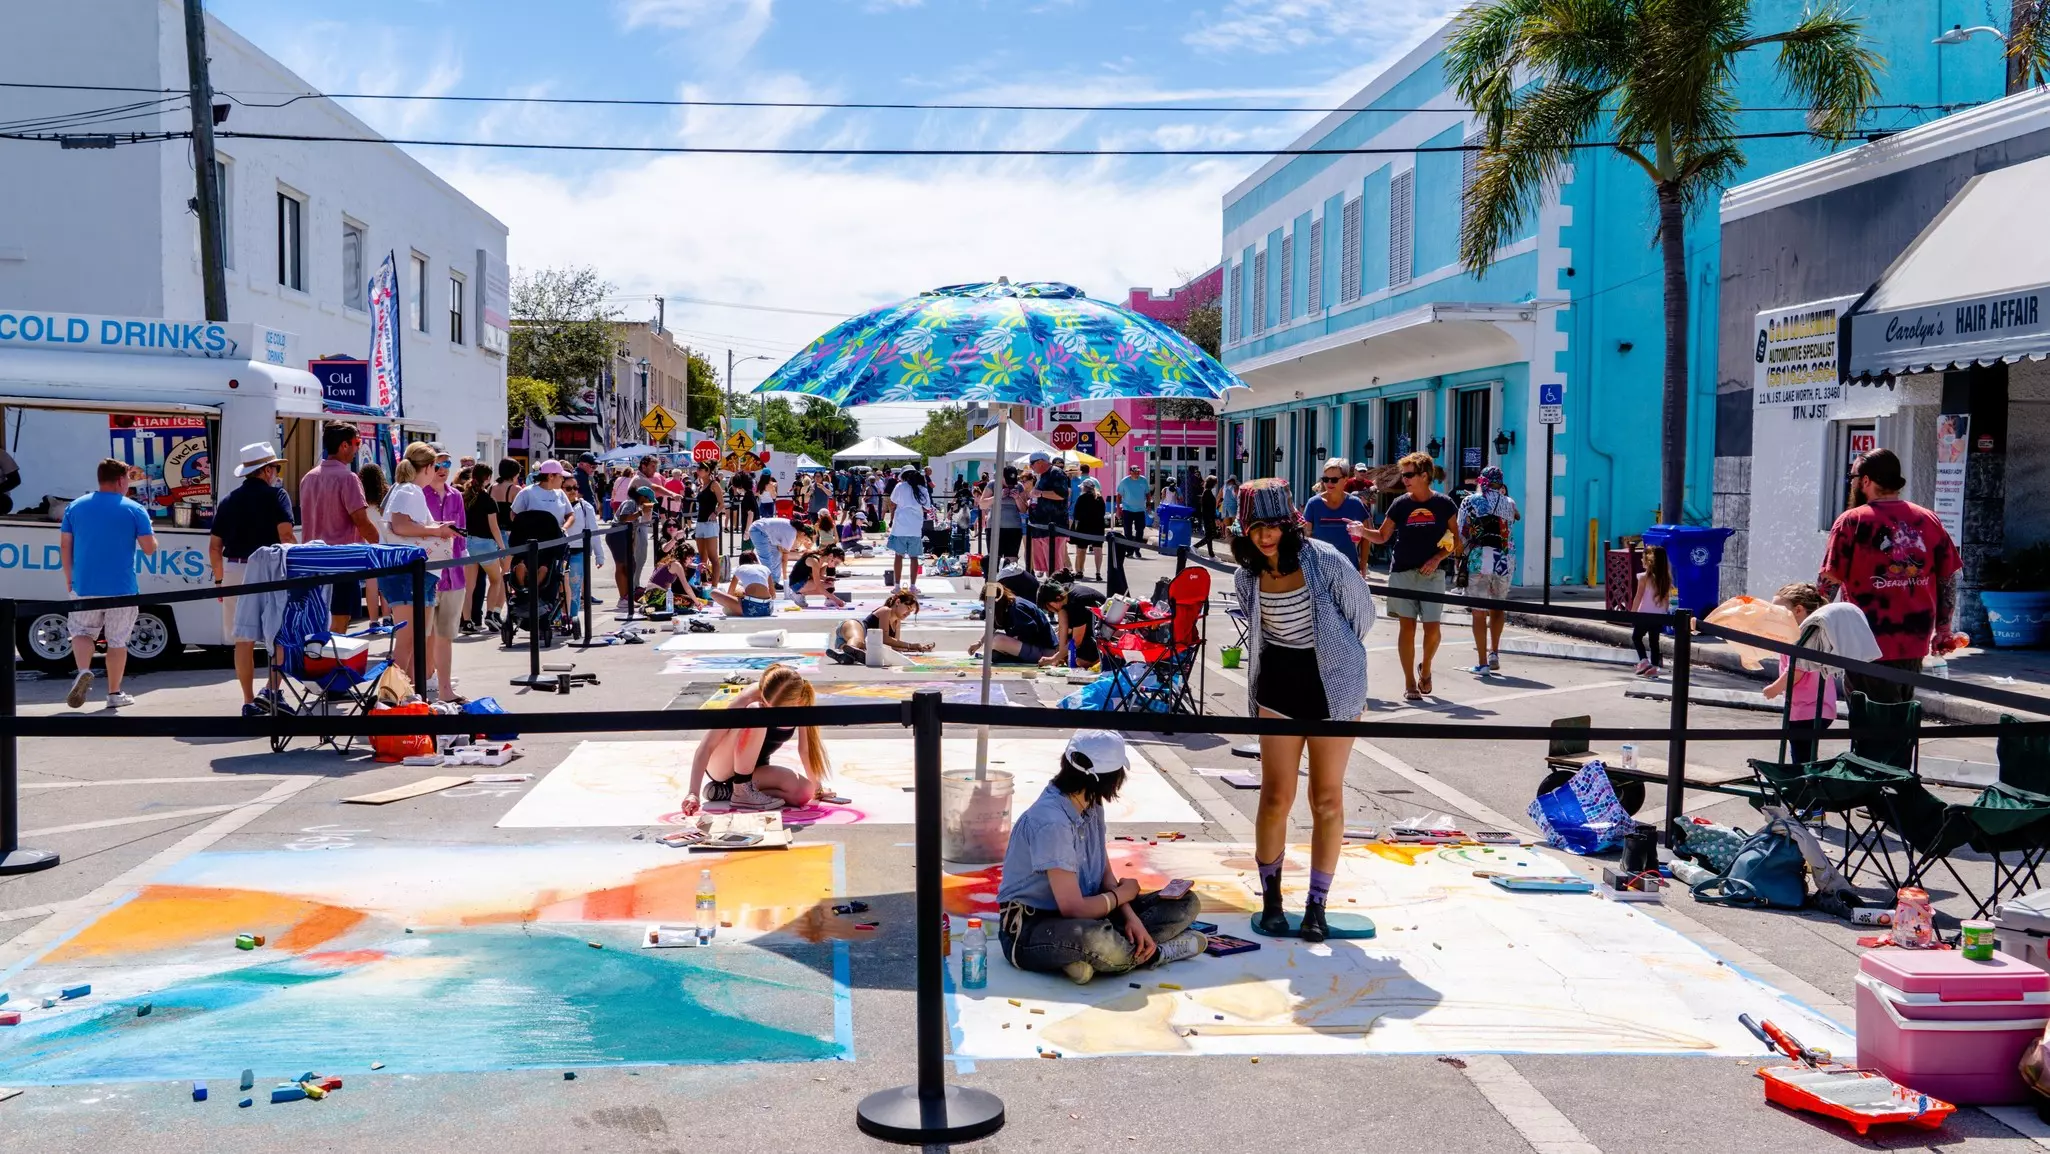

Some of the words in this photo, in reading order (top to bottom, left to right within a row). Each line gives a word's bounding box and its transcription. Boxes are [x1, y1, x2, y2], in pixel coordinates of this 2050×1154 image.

[1790, 309, 1836, 340] LOCKSMITH
[1886, 312, 1944, 345] Carolyn's
[1956, 304, 1986, 334] HAIR
[1990, 296, 2038, 329] AFFAIR
[0, 314, 89, 343] COLD
[100, 320, 226, 351] DRINKS
[273, 333, 286, 346] COLD
[267, 350, 284, 363] DRINKS
[1769, 346, 1802, 363] AUTOMOTIVE
[1803, 341, 1835, 359] SPECIALIST
[329, 372, 352, 384] Old
[327, 385, 355, 396] Town
[1759, 393, 1766, 404] 11
[1783, 390, 1795, 402] LAKE
[1824, 387, 1841, 399] 33460
[1793, 405, 1800, 419] 11
[1809, 405, 1816, 418] J
[1817, 404, 1828, 418] ST.
[133, 417, 168, 426] LIAN
[173, 417, 203, 426] ICES
[1053, 432, 1077, 442] STOP
[170, 443, 199, 465] Uncle
[694, 448, 720, 460] STOP
[136, 550, 204, 577] NKS
